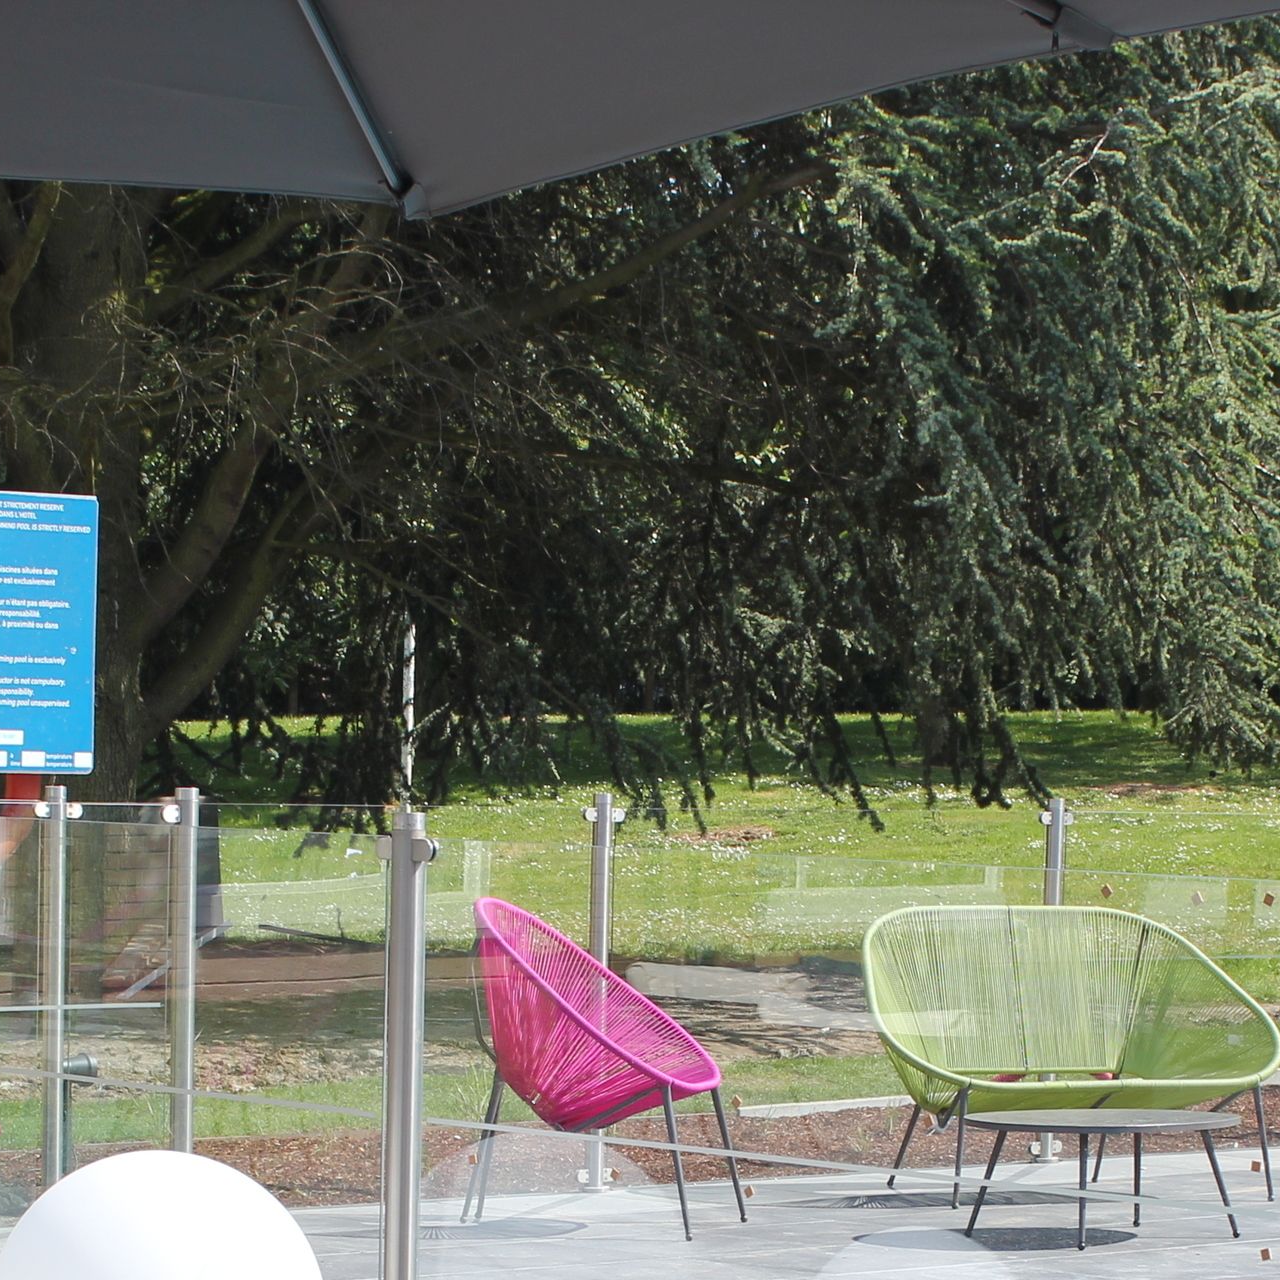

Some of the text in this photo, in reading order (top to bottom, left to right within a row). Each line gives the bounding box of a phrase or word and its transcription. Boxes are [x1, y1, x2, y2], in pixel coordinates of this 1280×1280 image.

[21, 566, 42, 575] situées
[43, 567, 58, 575] dans
[3, 576, 13, 584] est
[14, 576, 56, 586] exclusivement
[5, 598, 26, 606] n'étant
[7, 620, 34, 630] proximité
[44, 621, 59, 630] dans
[14, 655, 28, 664] pool
[34, 655, 66, 666] exclusively
[16, 698, 30, 708] pool
